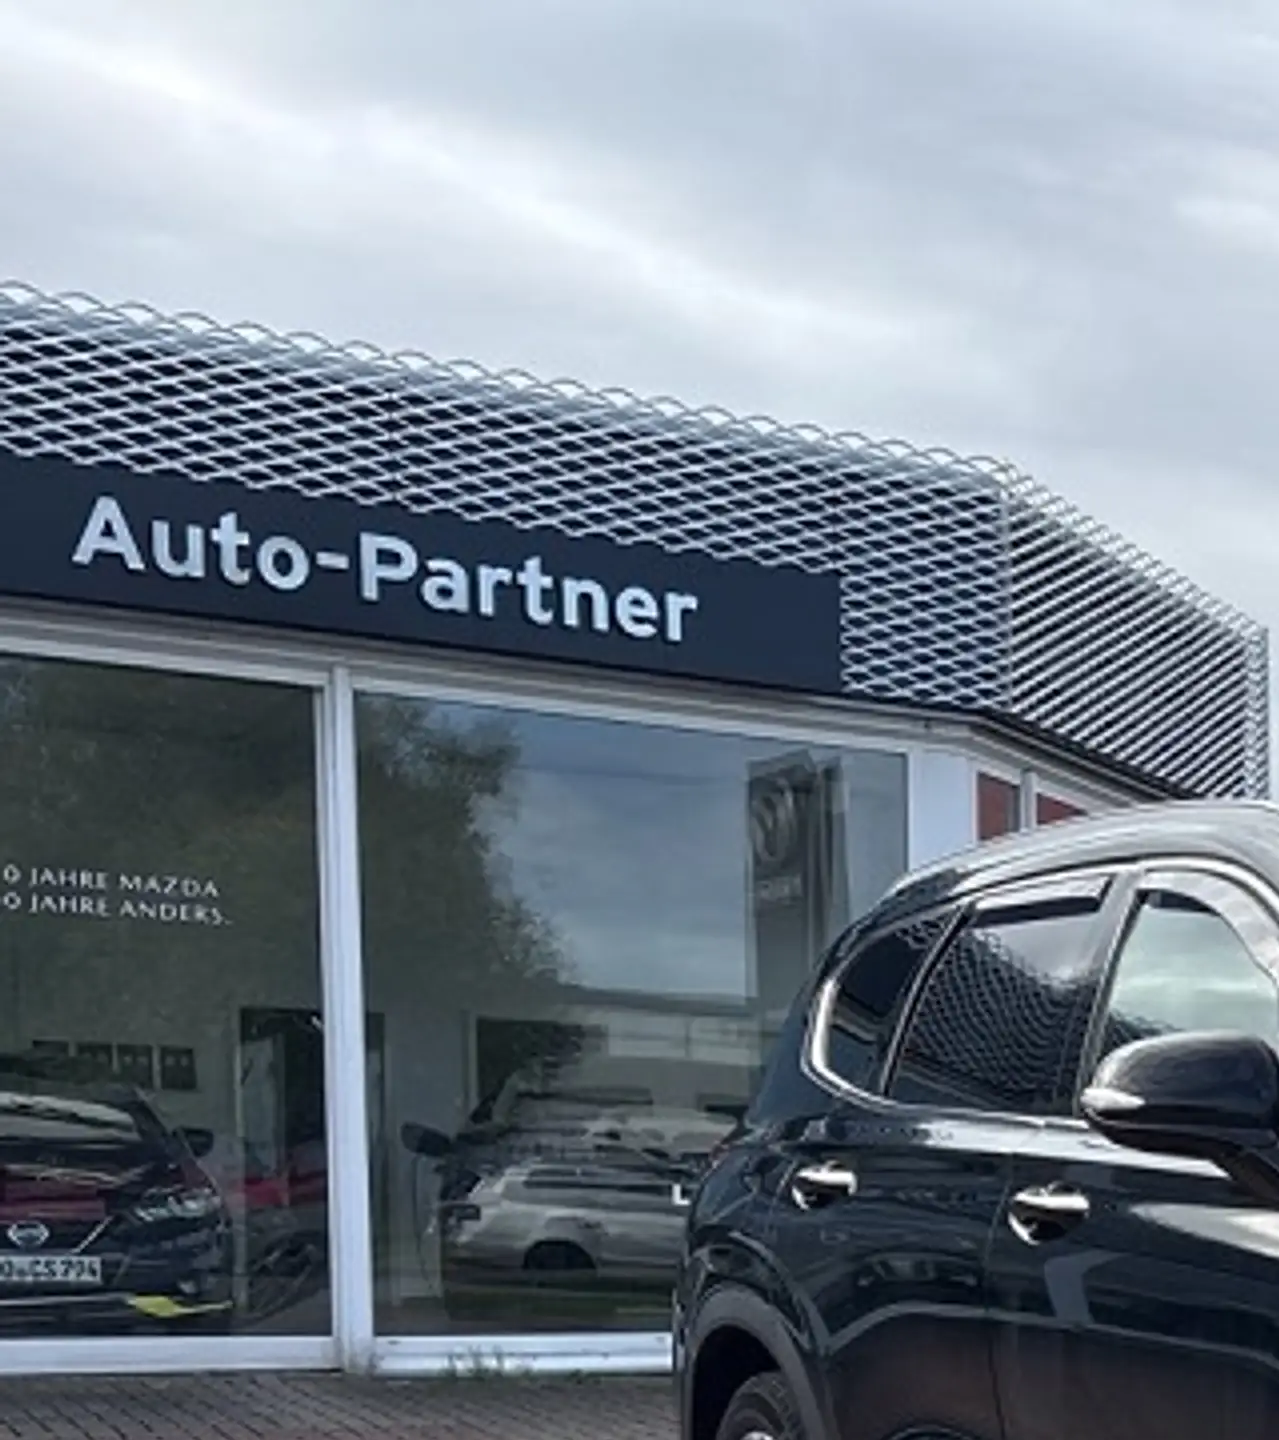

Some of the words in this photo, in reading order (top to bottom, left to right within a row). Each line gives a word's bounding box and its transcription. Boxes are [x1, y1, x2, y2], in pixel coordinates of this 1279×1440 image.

[72, 495, 697, 642] Auto-Partner
[29, 867, 108, 891] JAHRE
[119, 873, 220, 899] MAZDA
[28, 892, 111, 917] JAHRE
[119, 899, 233, 926] ANDERS.
